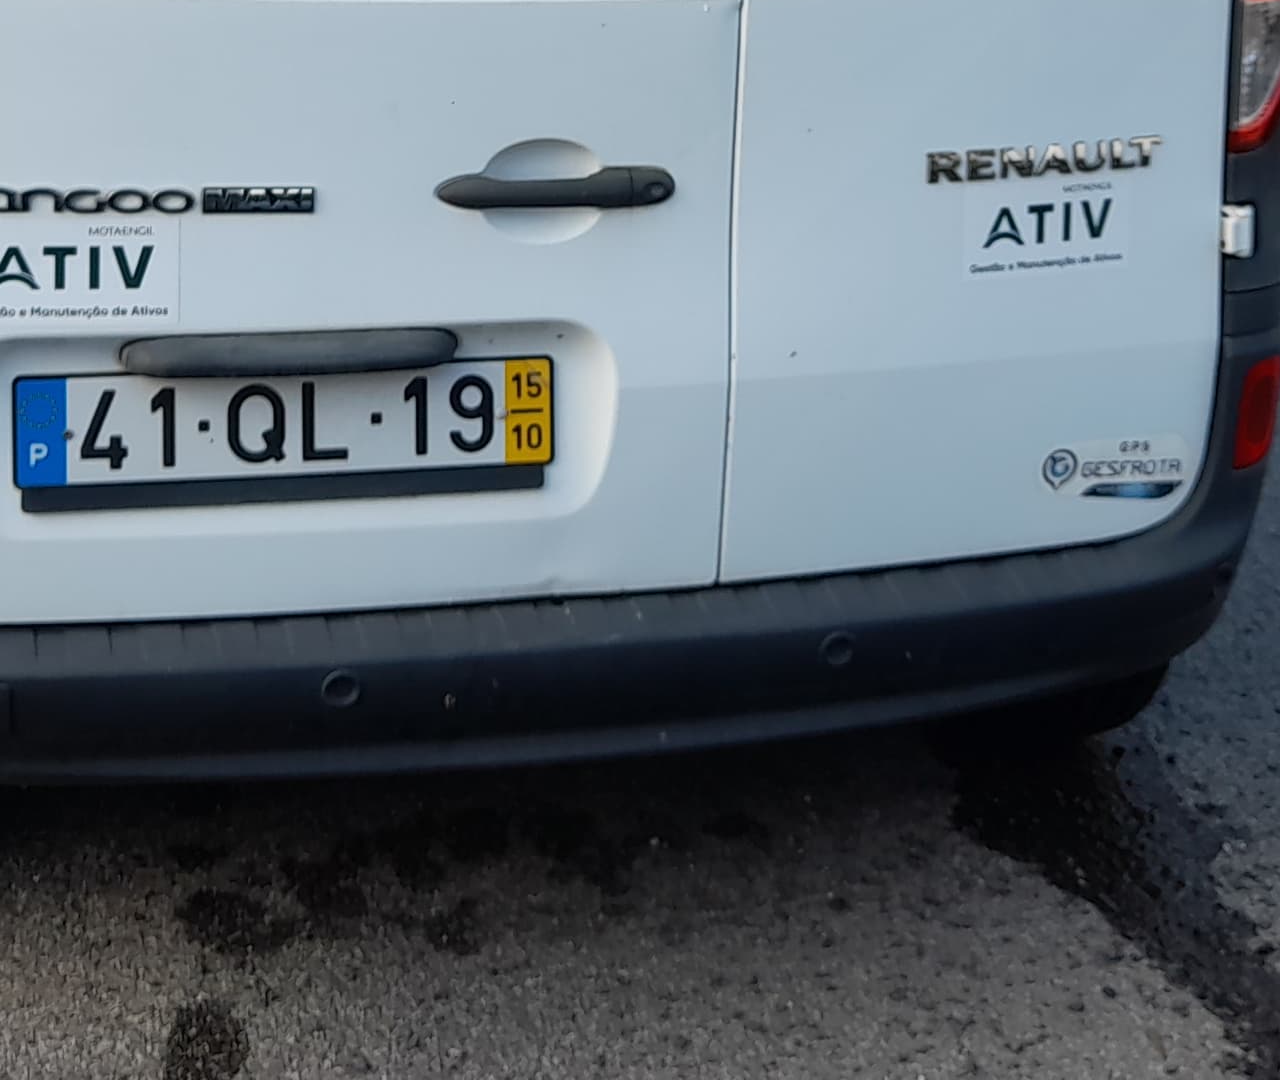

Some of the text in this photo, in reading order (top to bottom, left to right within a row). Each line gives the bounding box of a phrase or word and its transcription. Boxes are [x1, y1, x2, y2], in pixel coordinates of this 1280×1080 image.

[926, 135, 1162, 184] RENAULT
[203, 187, 314, 213] MAXI
[983, 198, 1112, 248] ATIV
[19, 308, 27, 317] e
[31, 306, 109, 319] Manutenção
[111, 304, 128, 317] de
[131, 304, 169, 316] Ativos
[511, 372, 543, 399] 15
[511, 423, 543, 451] 10
[28, 442, 49, 468] P
[1081, 458, 1181, 477] GESFROTA
